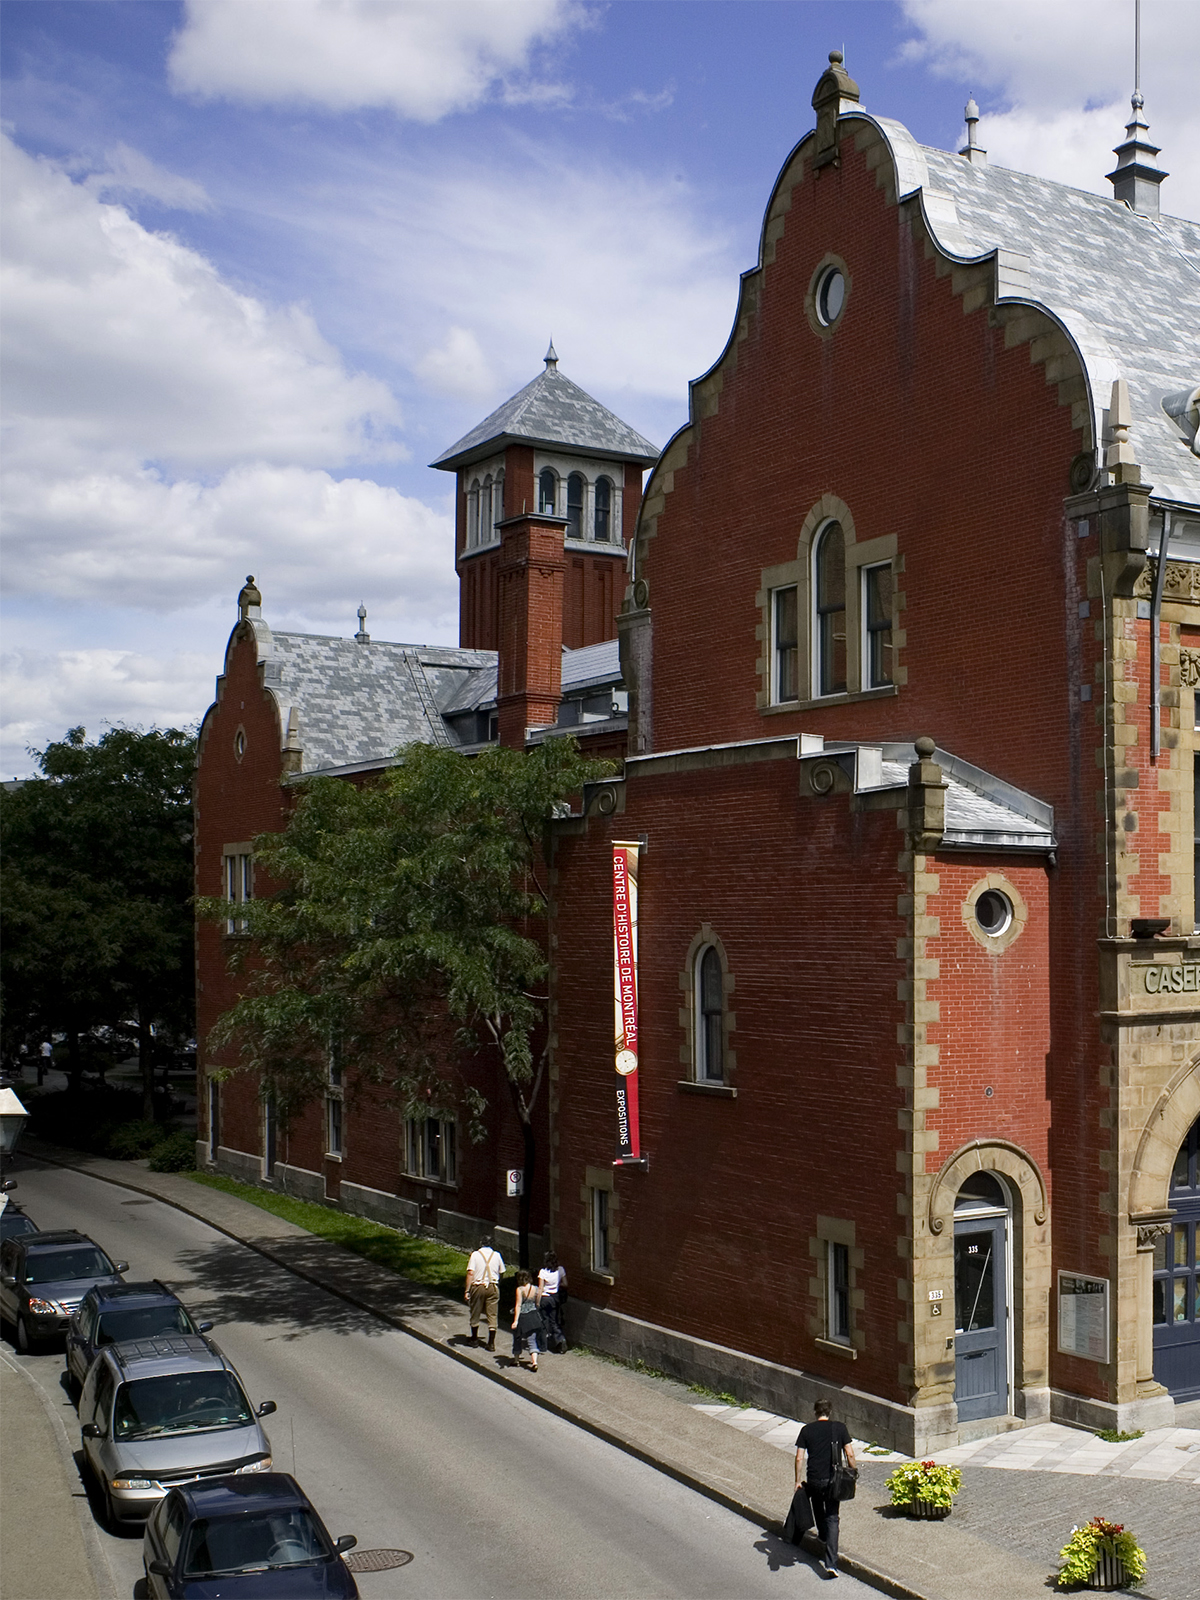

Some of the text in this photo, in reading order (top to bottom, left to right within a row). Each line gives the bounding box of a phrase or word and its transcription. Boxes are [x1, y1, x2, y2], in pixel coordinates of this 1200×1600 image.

[613, 856, 638, 1046] CENTRE D'HISTOIRE DE MONTRÉAL
[616, 1090, 629, 1146] EXPOSITIONS
